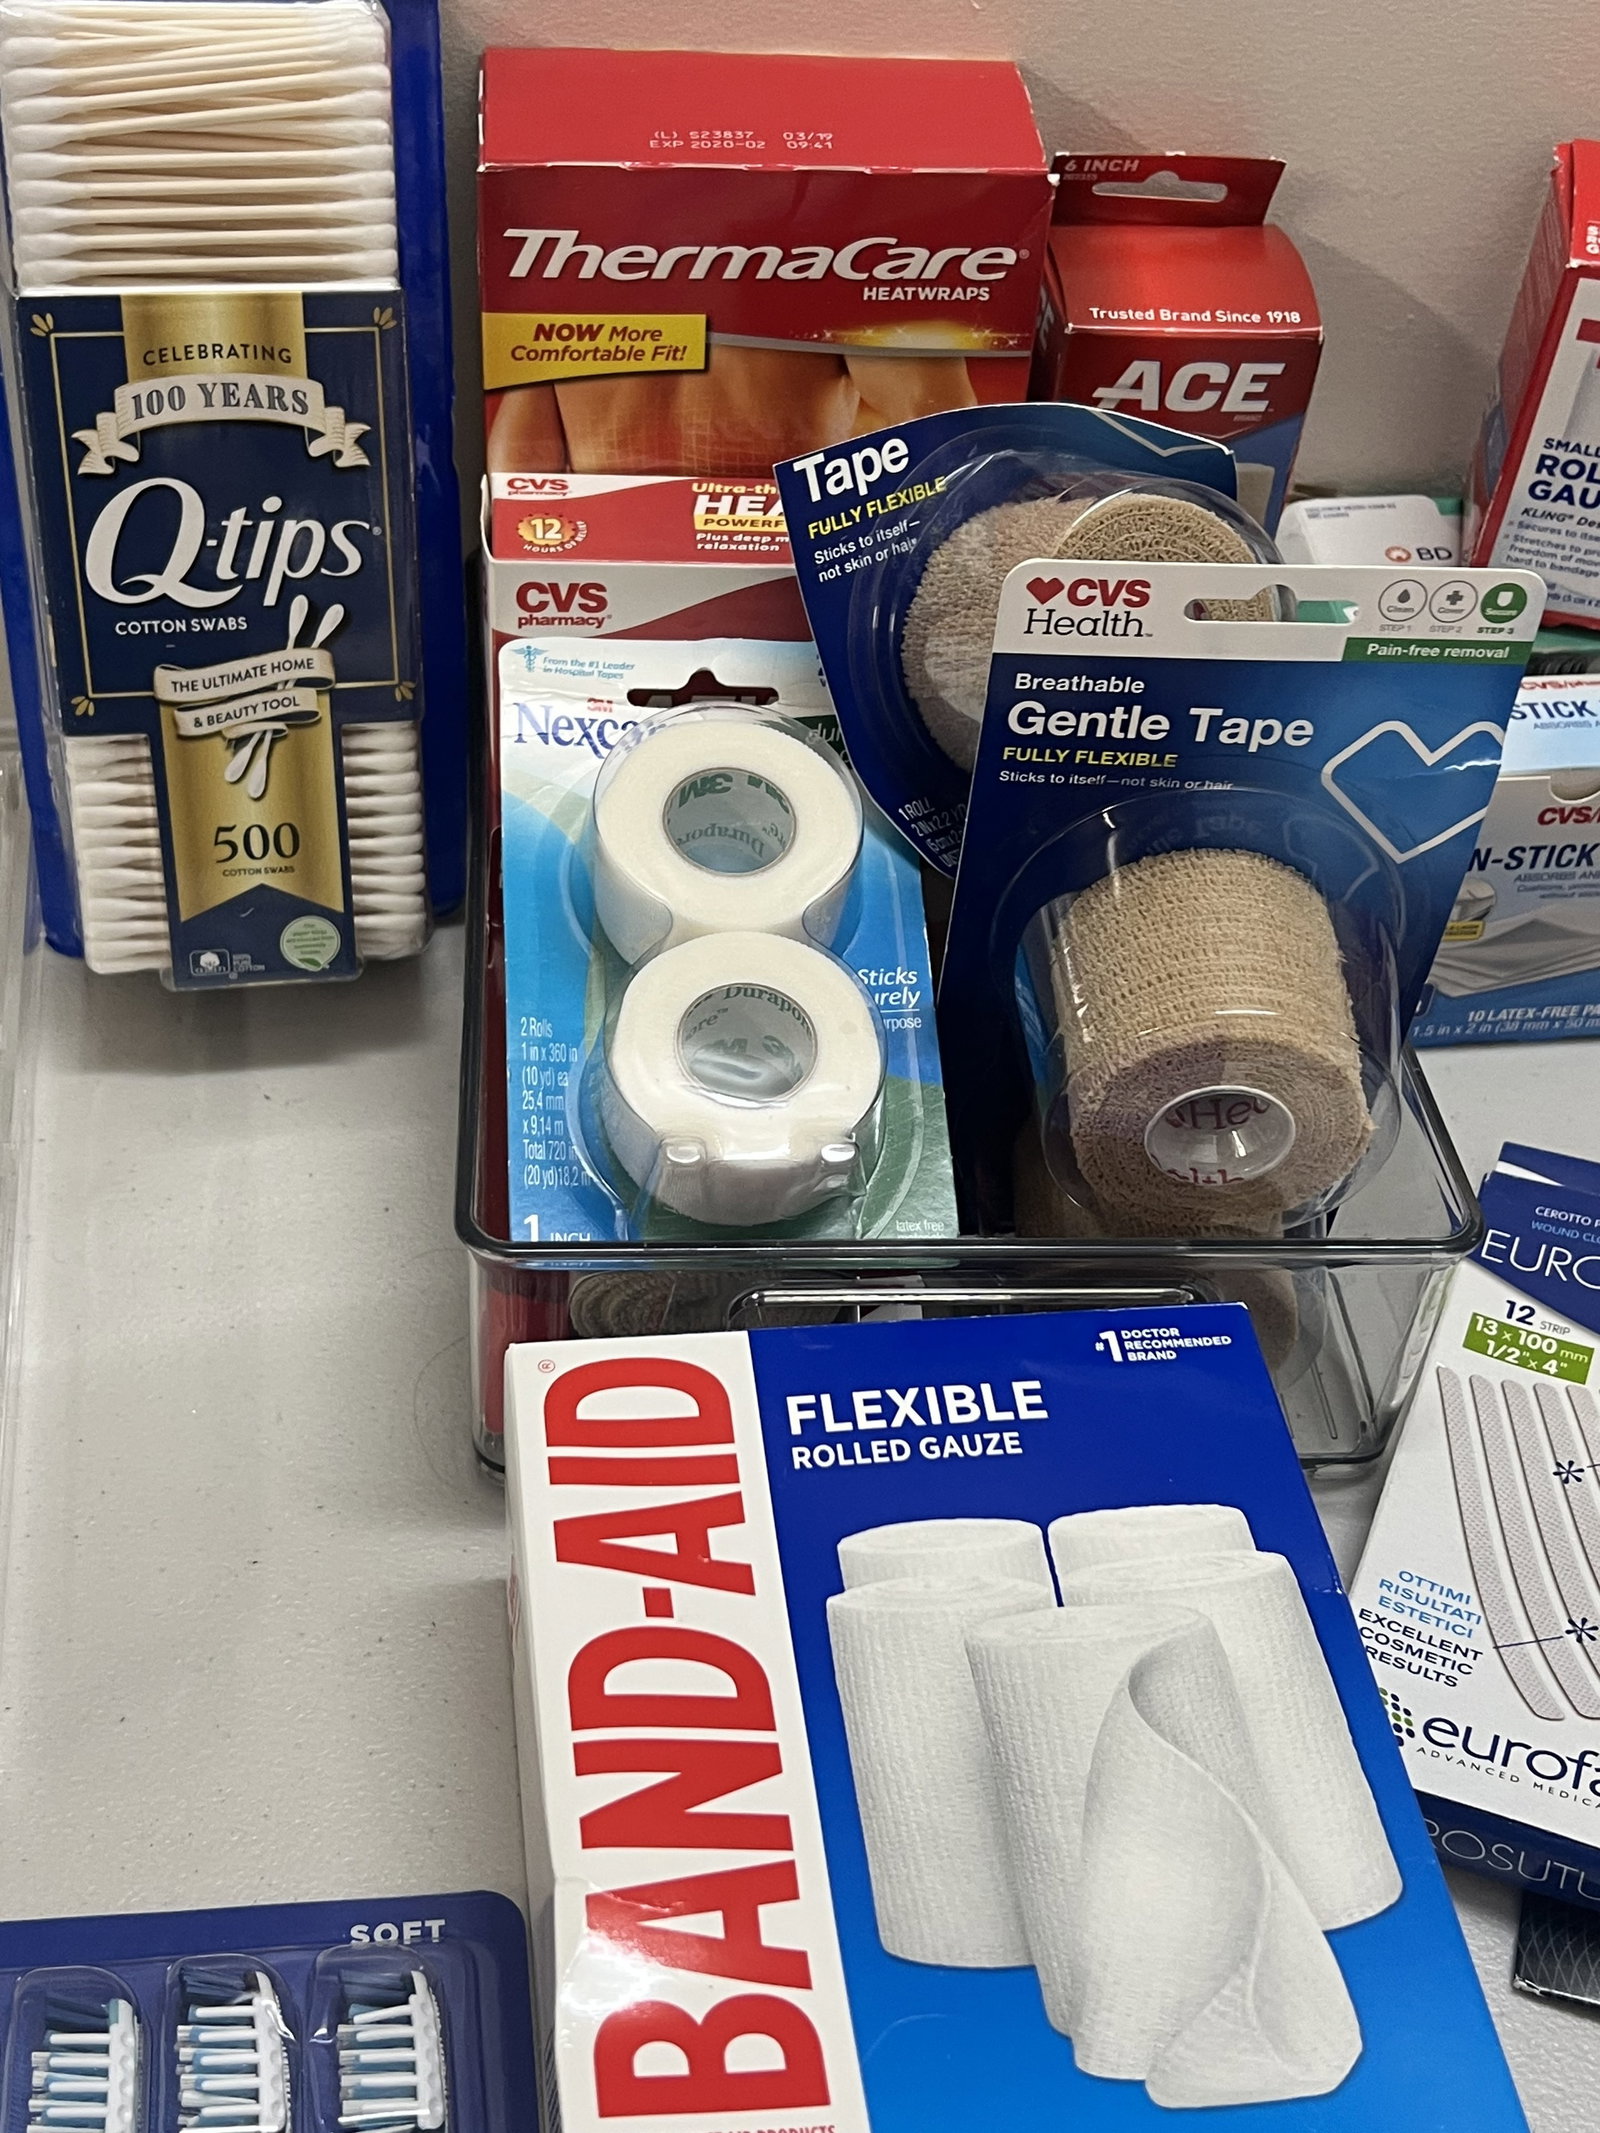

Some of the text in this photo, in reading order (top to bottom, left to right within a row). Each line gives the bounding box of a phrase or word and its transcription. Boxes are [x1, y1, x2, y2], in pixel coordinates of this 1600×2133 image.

[649, 140, 833, 149] EXP 2020-02 09:41
[654, 130, 678, 140] (L)
[783, 131, 833, 141] 03/19
[1064, 159, 1140, 172] 6 INCH
[503, 227, 1019, 281] ThermaCare
[863, 286, 990, 301] HEATWRAPS
[1089, 307, 1301, 324] Trusted Brand Since 1918
[534, 323, 662, 342] NOW More
[143, 343, 292, 366] CELEBRATING
[510, 344, 686, 363] Comfortable Fit!
[1091, 360, 1286, 413] ACE
[131, 381, 309, 420] 100 YEARS
[793, 437, 909, 502] Tape
[507, 477, 569, 492] CVS
[508, 490, 570, 498] pharmacy
[808, 475, 947, 540] FULLY FLEXIBLE
[531, 518, 562, 540] 12
[696, 533, 763, 545] Plus deep
[1517, 521, 1577, 539] Secures to
[85, 477, 370, 608] Q-tips
[523, 544, 564, 553] HOURS
[697, 543, 780, 552] relaxation
[814, 534, 873, 565] Sticks to
[1509, 544, 1558, 560] freedom
[1513, 534, 1566, 551] Stretches
[818, 537, 917, 582] not skin or hair
[1417, 547, 1452, 561] BD
[1506, 555, 1599, 578] hard to bandage
[515, 581, 608, 613] CVS
[1067, 578, 1151, 608] CVS
[1386, 606, 1414, 615] Clean
[1437, 606, 1465, 615] Cover
[115, 616, 248, 637] COTTON SWABS
[518, 614, 606, 629] pharmacy
[1023, 608, 1144, 638] Health
[1379, 624, 1403, 633] STEP
[1429, 625, 1454, 633] STEP
[1477, 626, 1504, 635] STEP
[1367, 643, 1509, 659] Pain-free removal
[543, 657, 635, 671] From the #1 Leader
[554, 668, 624, 680] Hospital Tapes
[172, 658, 315, 693] THE ULTIMATE HOME
[1014, 672, 1145, 694] Breathable
[194, 696, 300, 728] & BEAUTY TOOL
[1007, 699, 1314, 753] Gentle Tape
[1003, 746, 1178, 768] FULLY FLEXIBLE
[999, 771, 1234, 791] Sticks to skin or hair
[904, 797, 935, 819] ROLL
[213, 822, 300, 863] 500
[1467, 843, 1600, 872] N-STICK
[222, 865, 295, 878] COTTON SWABS
[857, 966, 918, 986] Sticks
[1468, 1004, 1578, 1022] 10 LATEX-FREE
[521, 1017, 552, 1038] 2 Rolls
[1413, 1021, 1549, 1037] 1.5 in 2 in mm
[522, 1043, 577, 1062] 1 in x 360 in
[522, 1066, 568, 1092] (10 yd) ea
[546, 1094, 564, 1110] mm
[523, 1119, 528, 1132] x
[554, 1119, 563, 1136] m
[523, 1139, 566, 1160] Total 720
[524, 1165, 540, 1188] (20
[896, 1220, 944, 1231] latex free
[1535, 1206, 1592, 1227] CEROTTO
[523, 1214, 539, 1241] 1
[1531, 1220, 1579, 1240] WOUND
[1505, 1299, 1571, 1336] 12 STRIP
[1121, 1327, 1180, 1340] DOCTOR
[1124, 1335, 1232, 1351] RECOMMENDED
[1474, 1315, 1498, 1337] 13
[1518, 1330, 1558, 1355] 100
[1560, 1349, 1588, 1364] mm
[1095, 1330, 1123, 1363] #1
[1127, 1349, 1177, 1362] BRAND
[786, 1380, 1049, 1435] FLEXIBLE
[791, 1431, 1023, 1470] ROLLED GAUZE
[1398, 1570, 1471, 1605] OTTIMI
[1379, 1578, 1482, 1625] RISULTATI
[1378, 1595, 1473, 1639] ESTETICI
[1358, 1607, 1483, 1662] EXCELLENT
[1359, 1626, 1474, 1675] COSMETIC
[1364, 1645, 1458, 1688] RESULTS
[543, 1357, 832, 2118] BAND-AID
[1416, 1746, 1520, 1784] ADVANCED
[350, 1919, 446, 1946] SOFT
